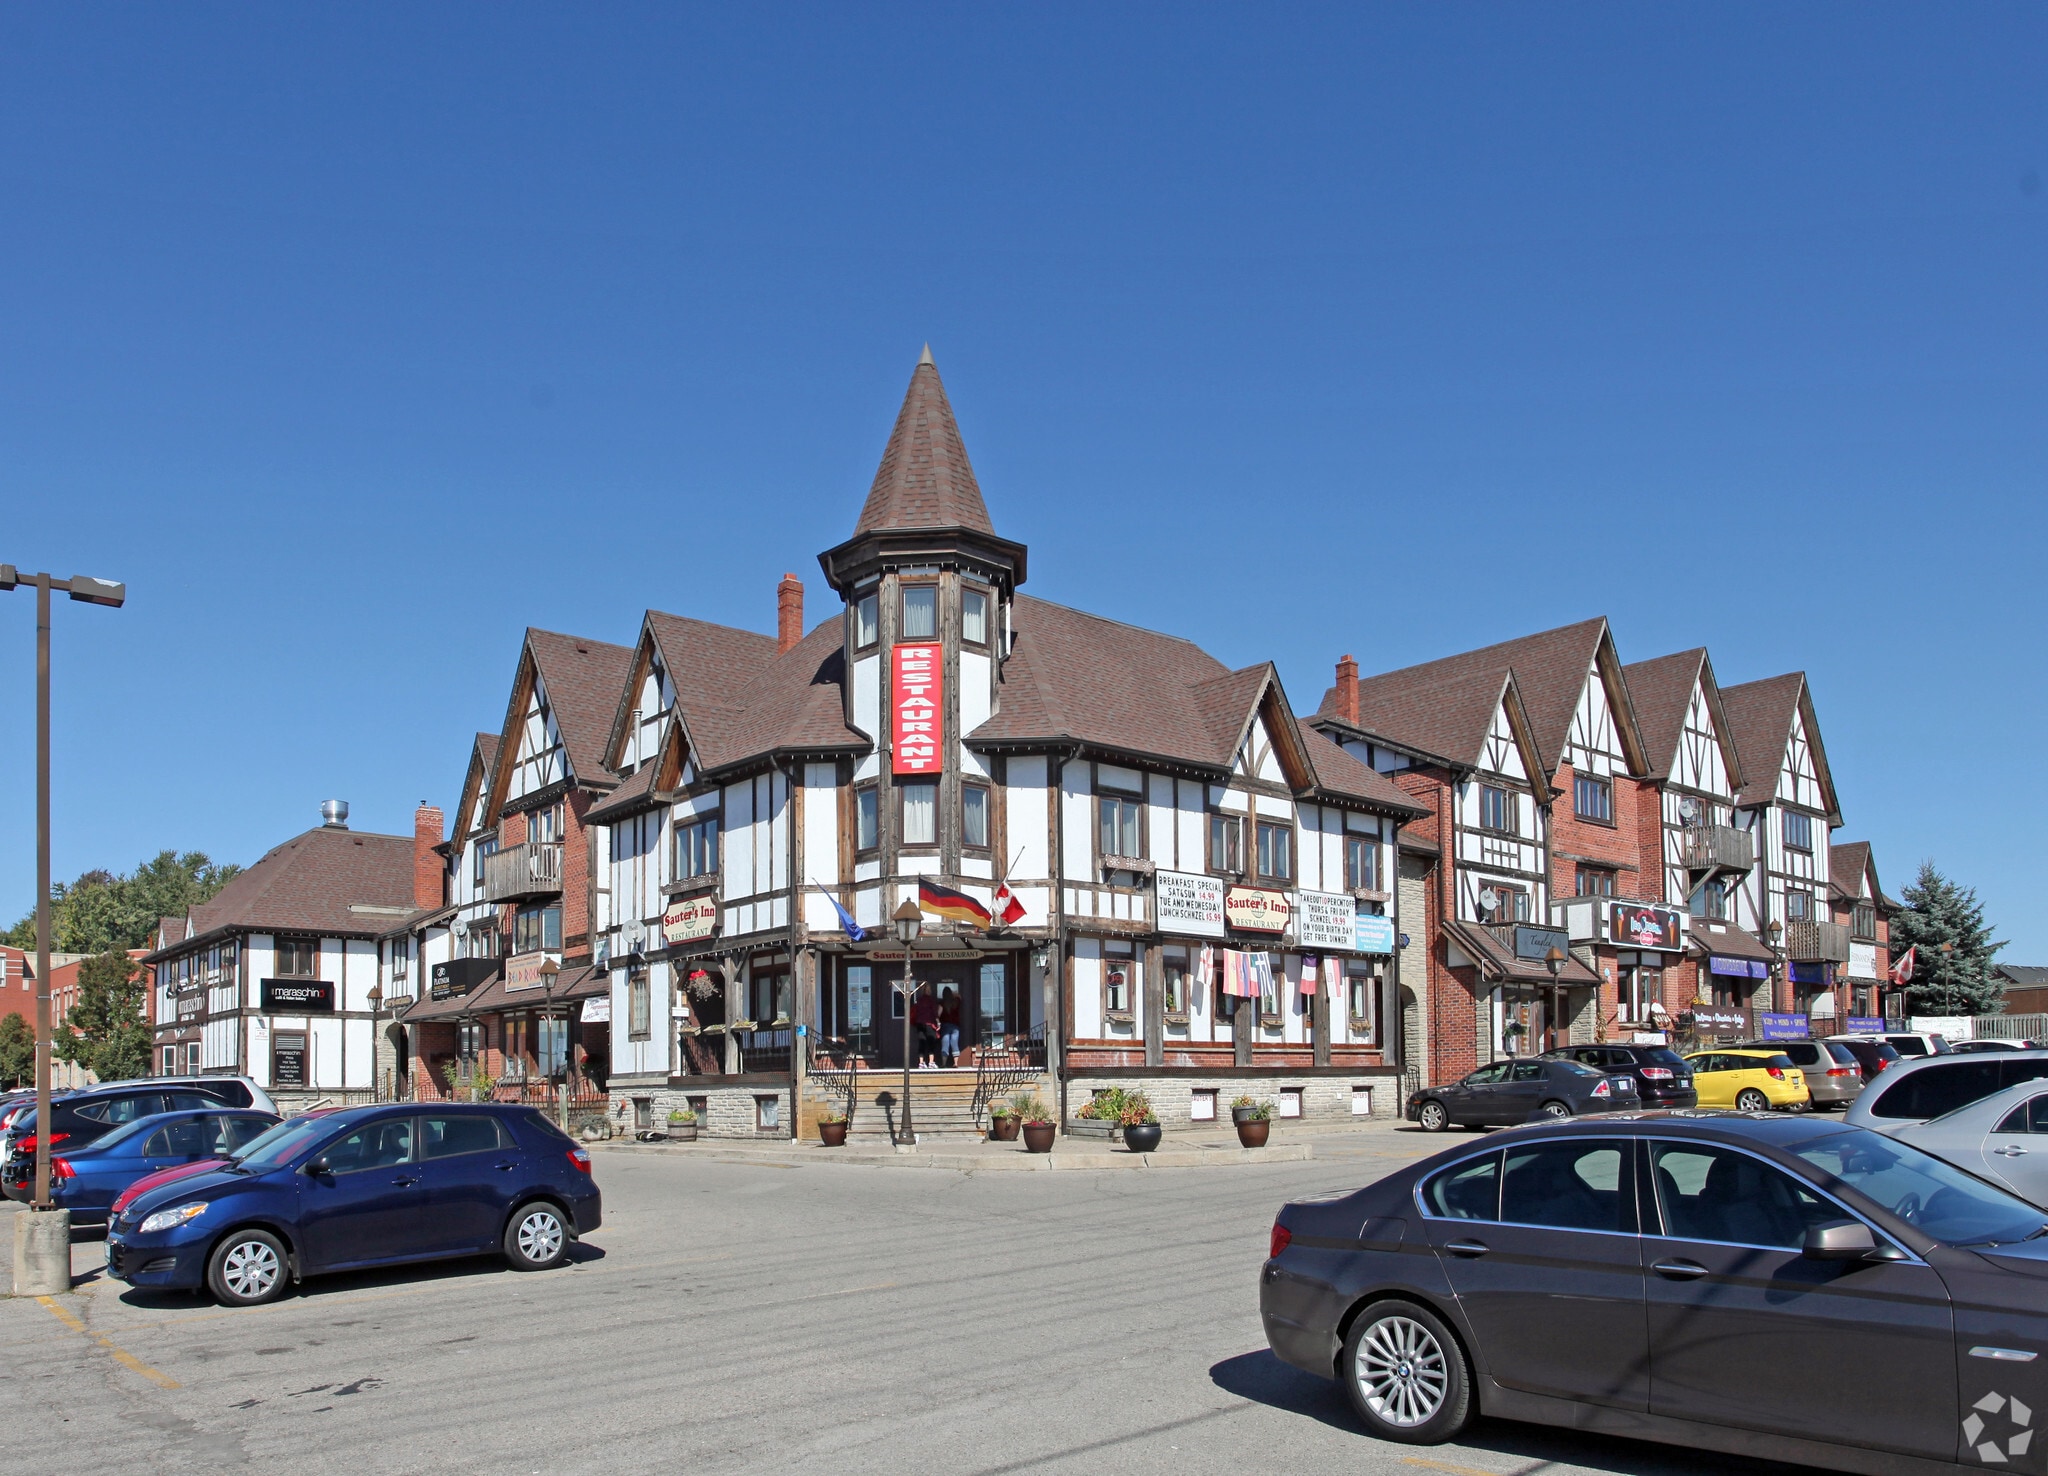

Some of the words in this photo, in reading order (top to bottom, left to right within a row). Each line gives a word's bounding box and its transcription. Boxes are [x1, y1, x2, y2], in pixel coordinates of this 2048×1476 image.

[899, 648, 936, 769] RESTAURANT
[1158, 875, 1195, 889] BREAKFAST
[1197, 880, 1222, 893] SPECIAL
[1199, 892, 1215, 901] $4.99
[1160, 896, 1171, 907] TUE
[1172, 898, 1185, 908] AND
[1186, 900, 1221, 912] WEDNESDAY
[1227, 896, 1268, 910] Sauter's
[1270, 899, 1287, 914] Inn
[664, 907, 699, 927] Sauter's
[700, 905, 715, 918] Inn
[1160, 907, 1179, 918] LUNCH
[1206, 912, 1221, 922] $5.99
[1235, 917, 1280, 929] RESTAURANT
[1303, 923, 1310, 931] ON
[1311, 923, 1325, 933] YOUR
[671, 927, 708, 941] RESTAURANT
[1303, 932, 1313, 941] GET
[1315, 933, 1327, 942] FREE
[1330, 934, 1347, 944] DINNER
[873, 951, 914, 959] Sauters
[915, 951, 933, 959] Inn
[937, 950, 980, 959] RESTAURANT
